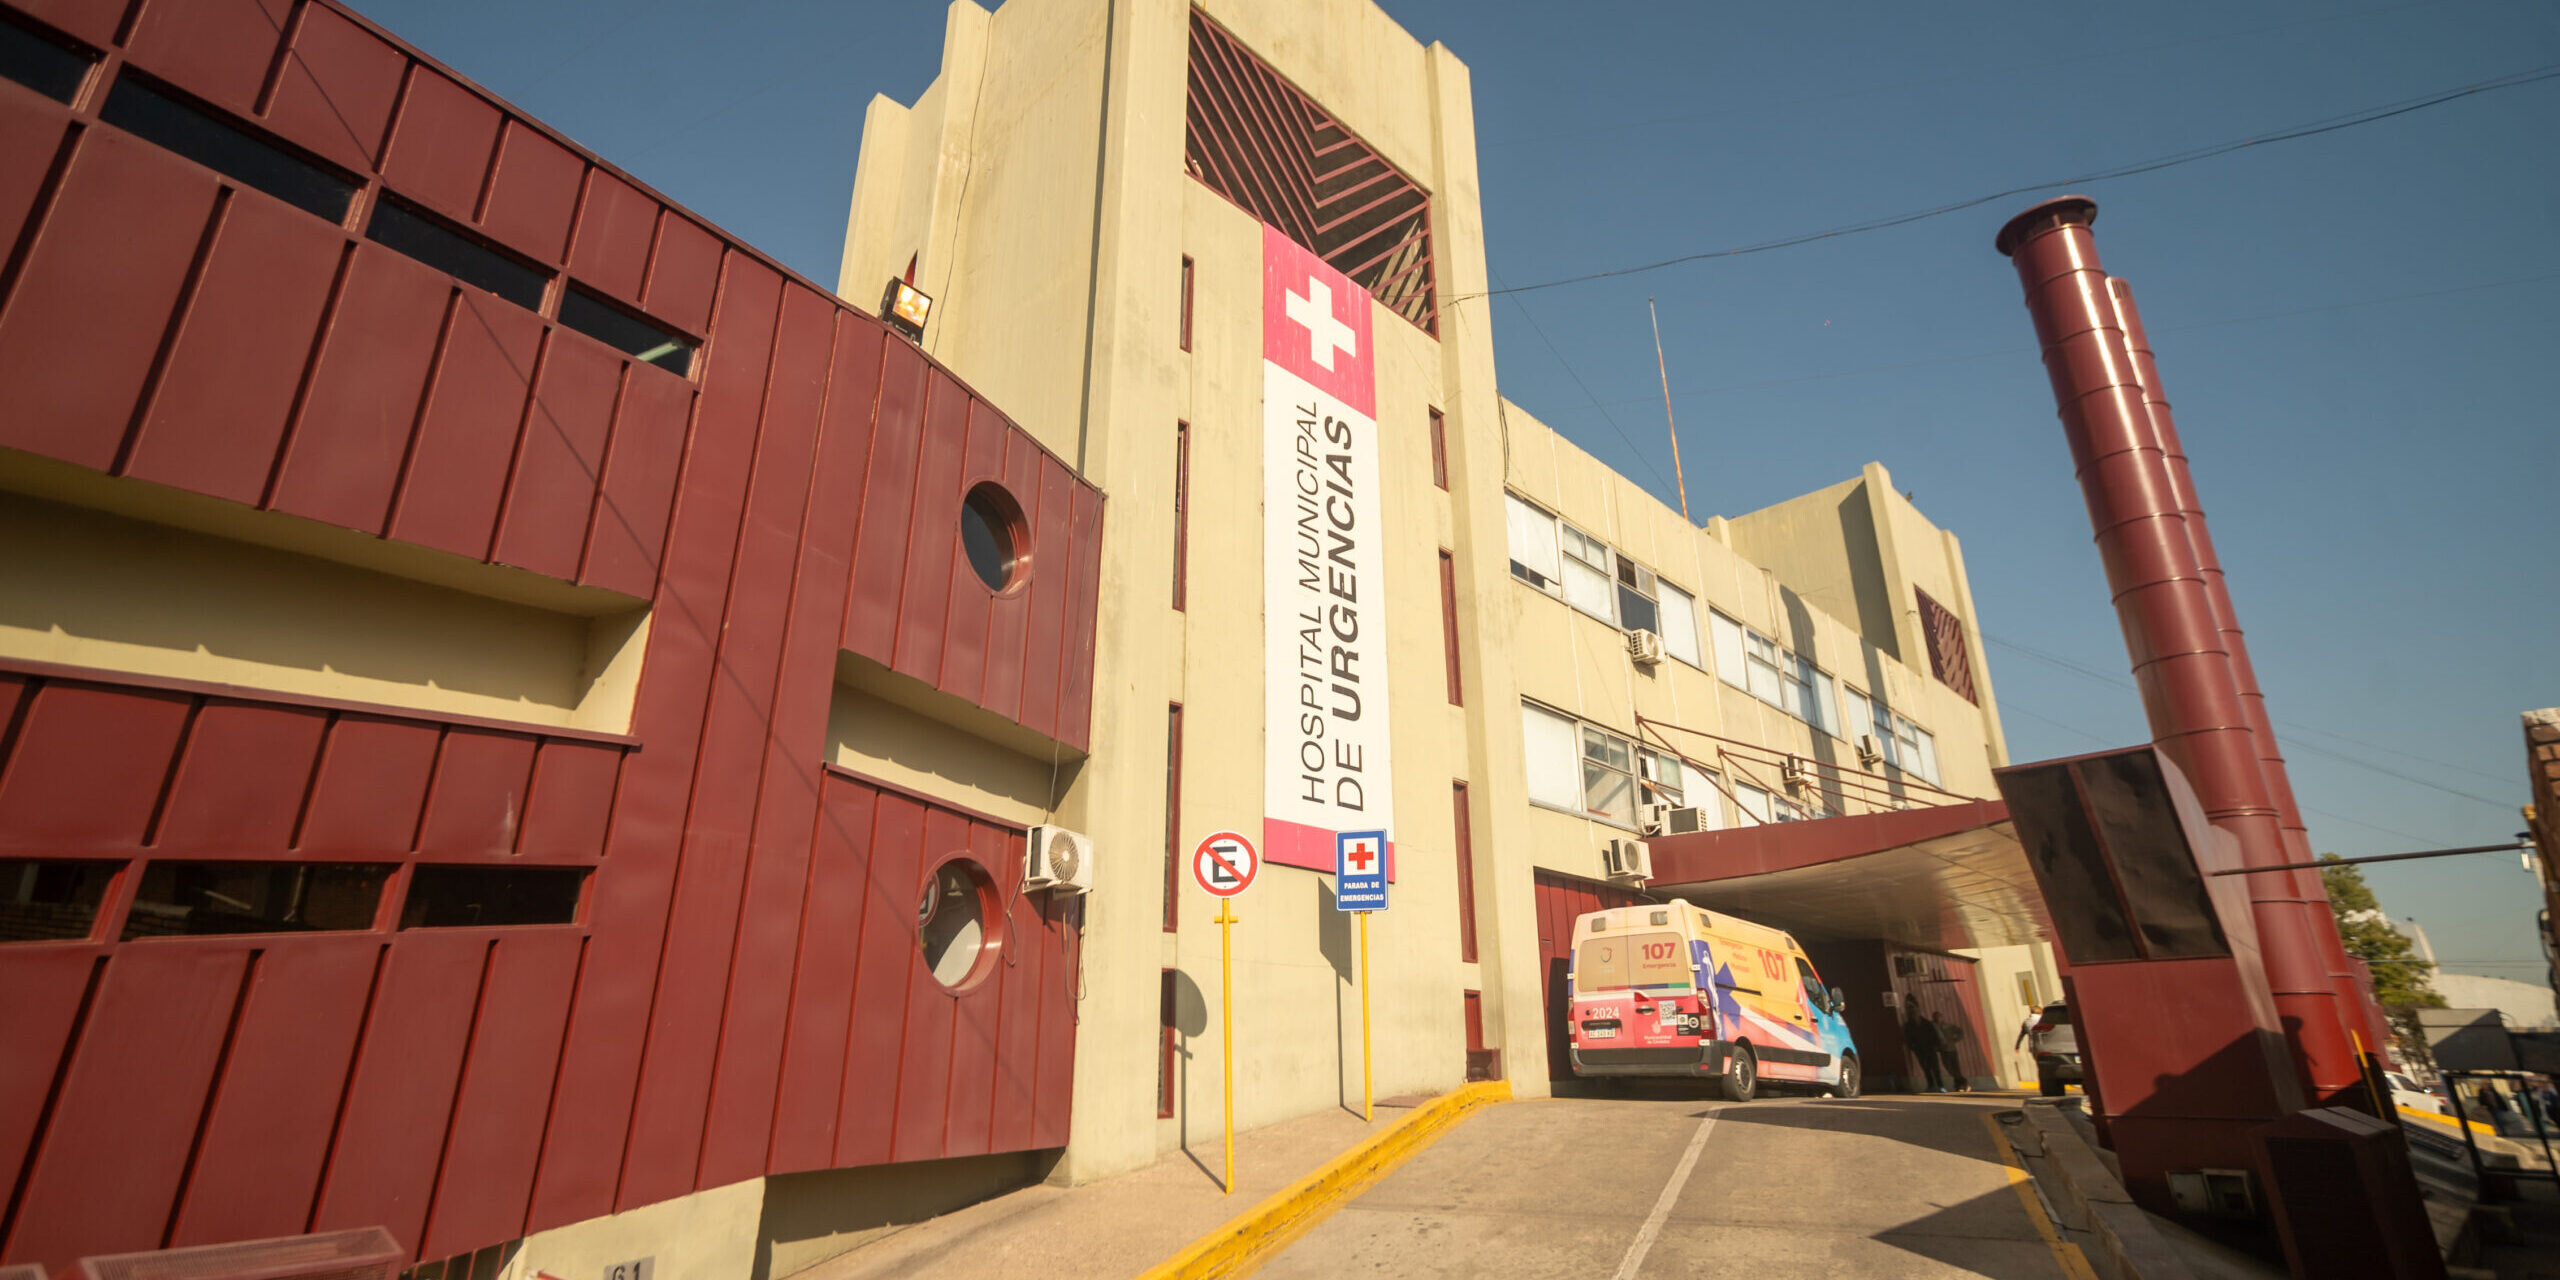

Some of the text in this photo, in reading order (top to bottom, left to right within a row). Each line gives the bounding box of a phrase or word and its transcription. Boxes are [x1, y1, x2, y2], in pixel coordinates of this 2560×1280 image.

[1296, 402, 1325, 805] HOSPITAL MUNICIPAL
[1324, 415, 1364, 812] DE URGENCIAS
[1212, 846, 1239, 883] E
[1340, 893, 1384, 902] EMERGENCIAS
[1343, 881, 1380, 890] PARADA DE
[1641, 942, 1676, 960] 107
[1757, 948, 1787, 982] 107
[1592, 1006, 1620, 1020] 2024
